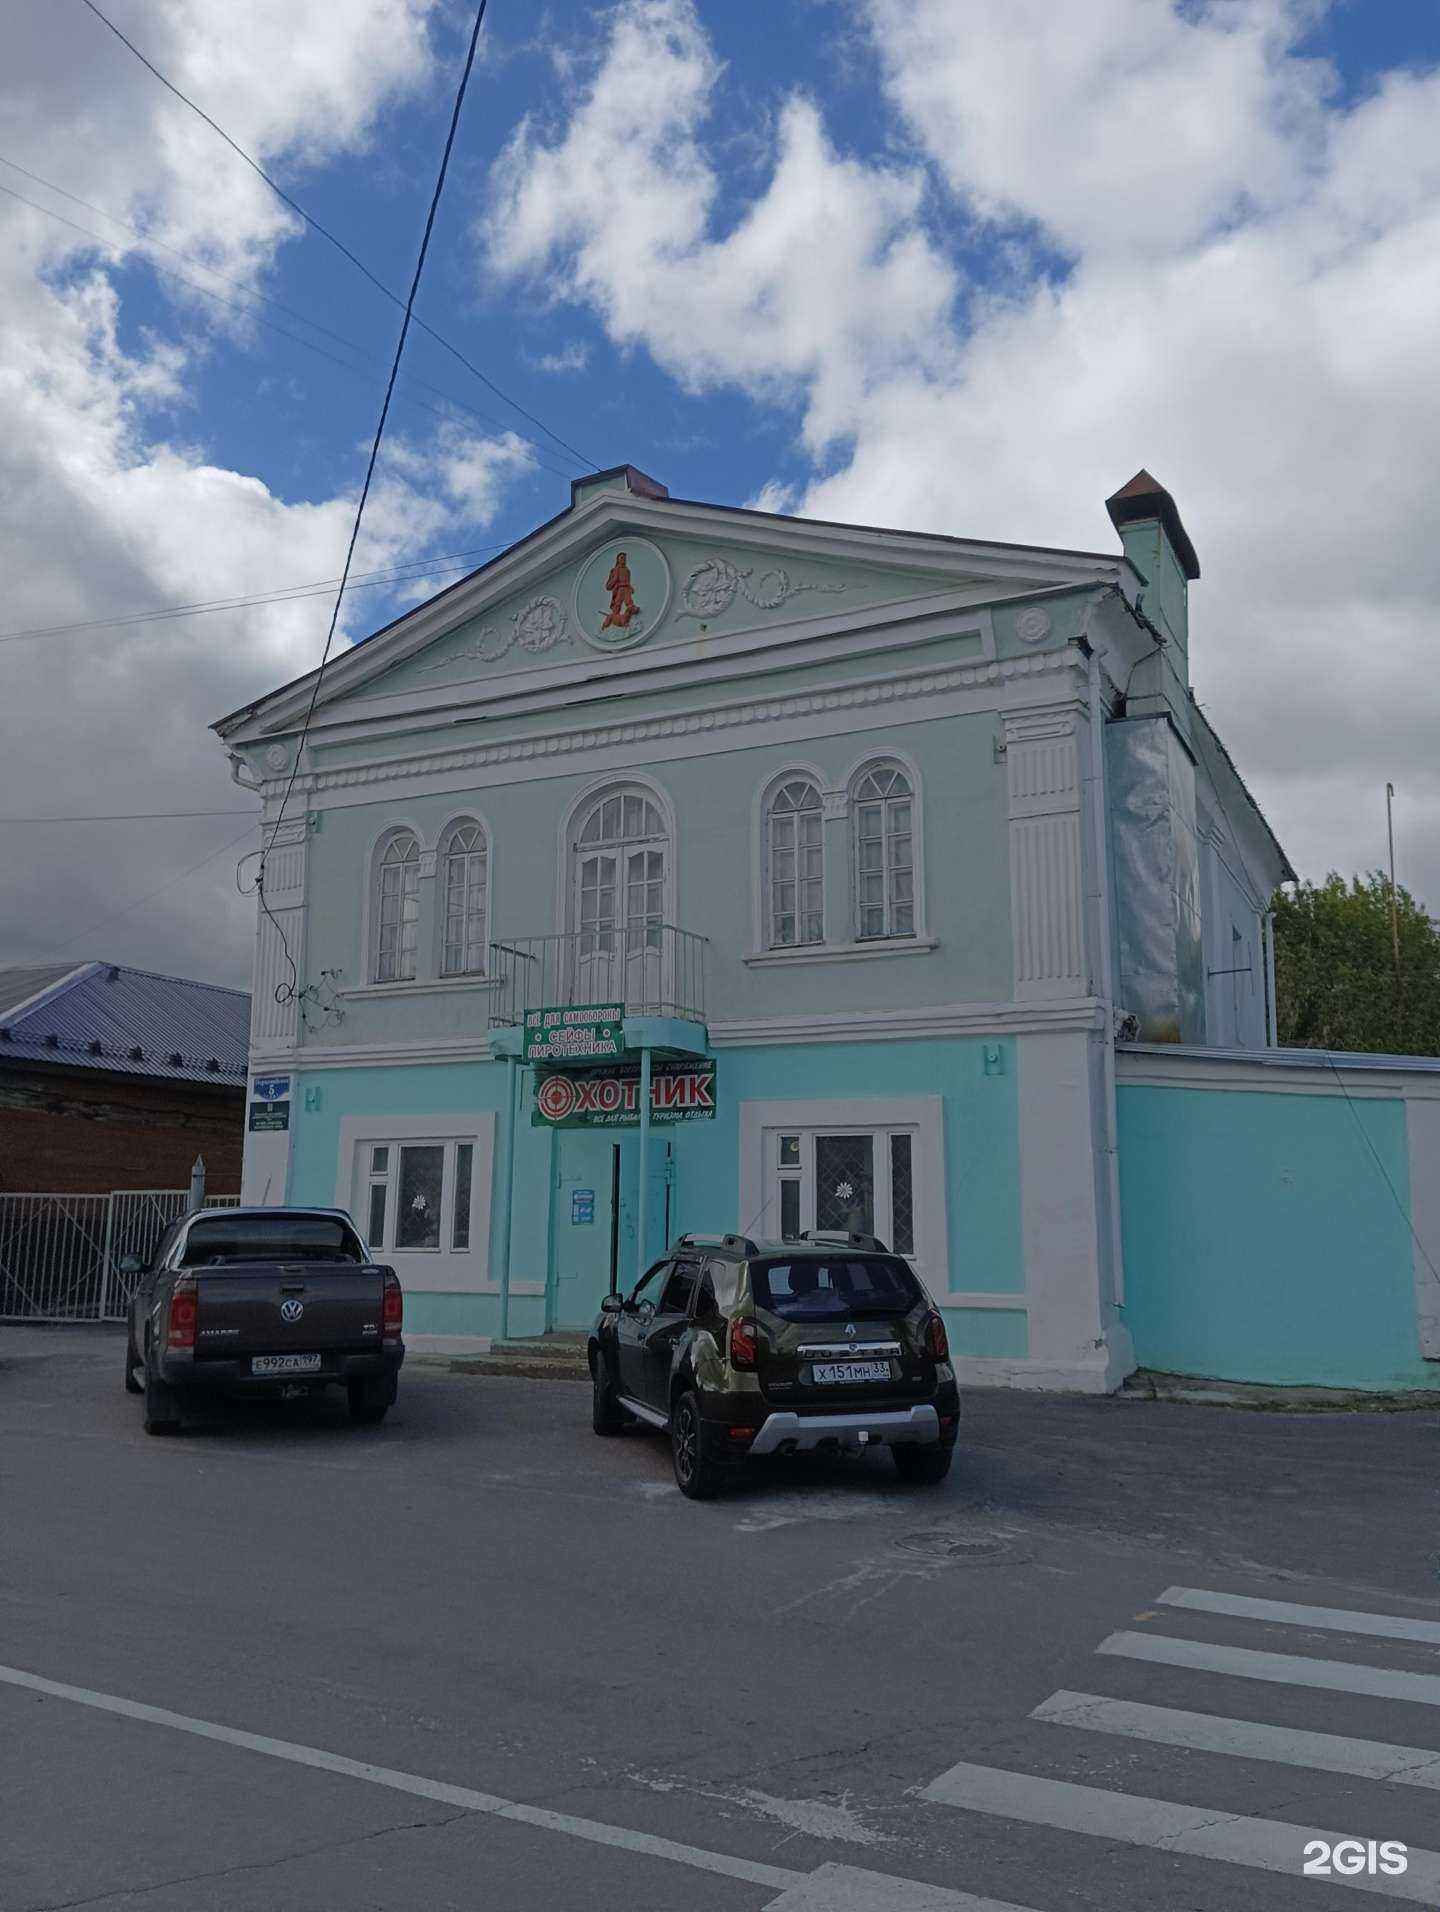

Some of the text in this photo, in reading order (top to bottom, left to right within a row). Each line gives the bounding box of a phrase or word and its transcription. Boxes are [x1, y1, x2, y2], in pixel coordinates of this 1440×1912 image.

[544, 1012, 561, 1029] ДЛЯ
[563, 1008, 620, 1025] САМООБОРОНЫ
[549, 1027, 596, 1043] СЕЙФЫ
[528, 1040, 617, 1058] ПИРОТЕХНИКА
